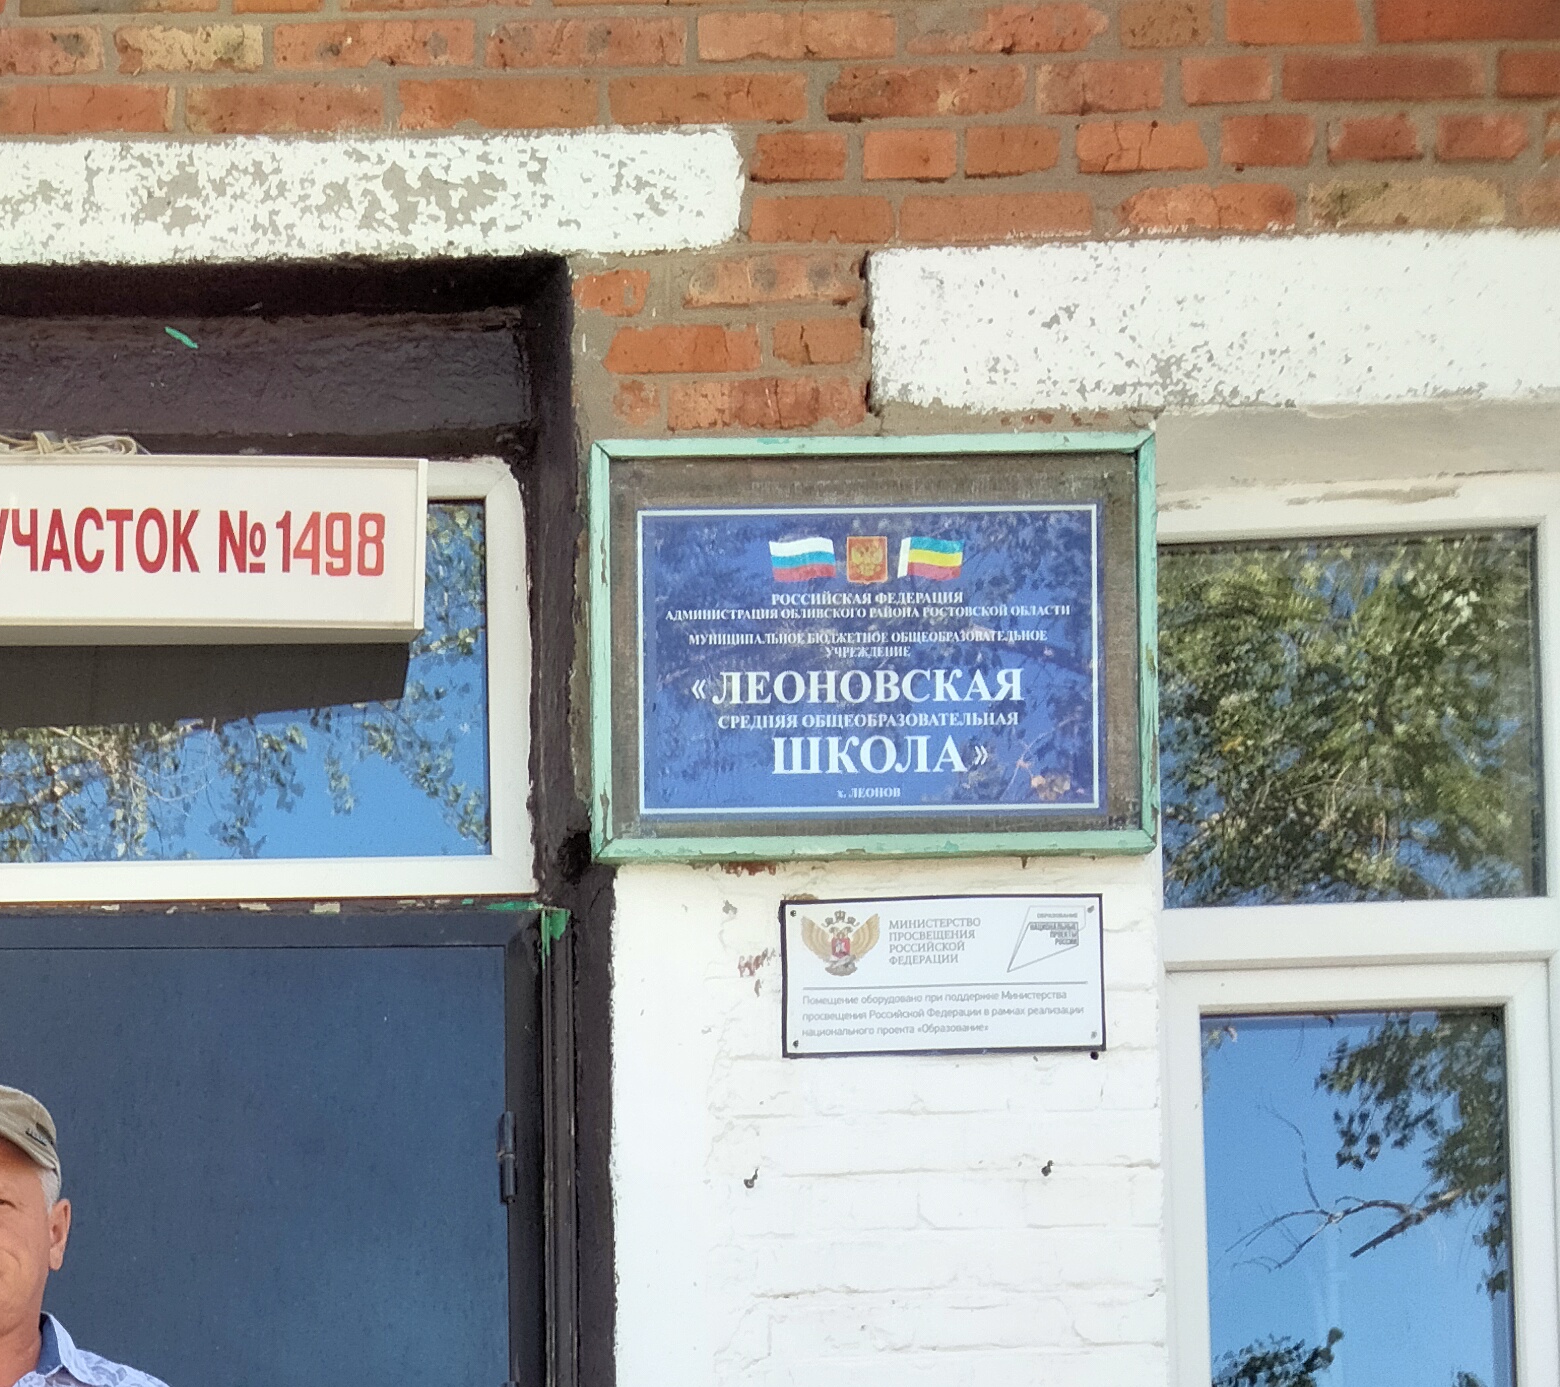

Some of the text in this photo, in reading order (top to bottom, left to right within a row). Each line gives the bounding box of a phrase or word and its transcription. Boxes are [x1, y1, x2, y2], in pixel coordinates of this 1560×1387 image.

[772, 591, 963, 605] РОССИЙСКАЯ ФЕДЕРАЦИЯ
[665, 608, 778, 621] АДМИНИСТРАЦИЯ
[870, 605, 919, 618] РАЙОНА
[923, 604, 1008, 617] РОСТОВСКОЙ
[1010, 604, 1071, 616] ОБЛАСТИ
[689, 630, 1048, 646] МУНИЦИПАЛЬНОЕ БЮДЖЕТНОЕ ОБЩЕОБРАЗОВАТЕЛЬНОЕ
[825, 646, 911, 659] УЧРЕЖДЕНИЕ
[717, 712, 1019, 730] СРЕДНЯЯ ОБЩЕОБРАЗОВАТЕЛЬНАЯ
[849, 787, 901, 799] ЛЕОНОВ
[888, 918, 981, 930] МИНИСТЕРСТВО
[888, 930, 976, 941] ПРОСВЕЩЕНИЯ
[889, 940, 965, 953] РОССИЙСКОЙ
[888, 954, 959, 965] ФЕДЕРАЦИИ
[802, 990, 1068, 1007] Помещение оборудовано при поддержке Министерства
[802, 1011, 867, 1022] просвещения
[869, 1008, 925, 1020] Российской
[926, 1007, 982, 1020] Федерации
[1027, 1006, 1085, 1017] реализации
[802, 1026, 875, 1038] национального
[877, 1025, 915, 1037] проекта
